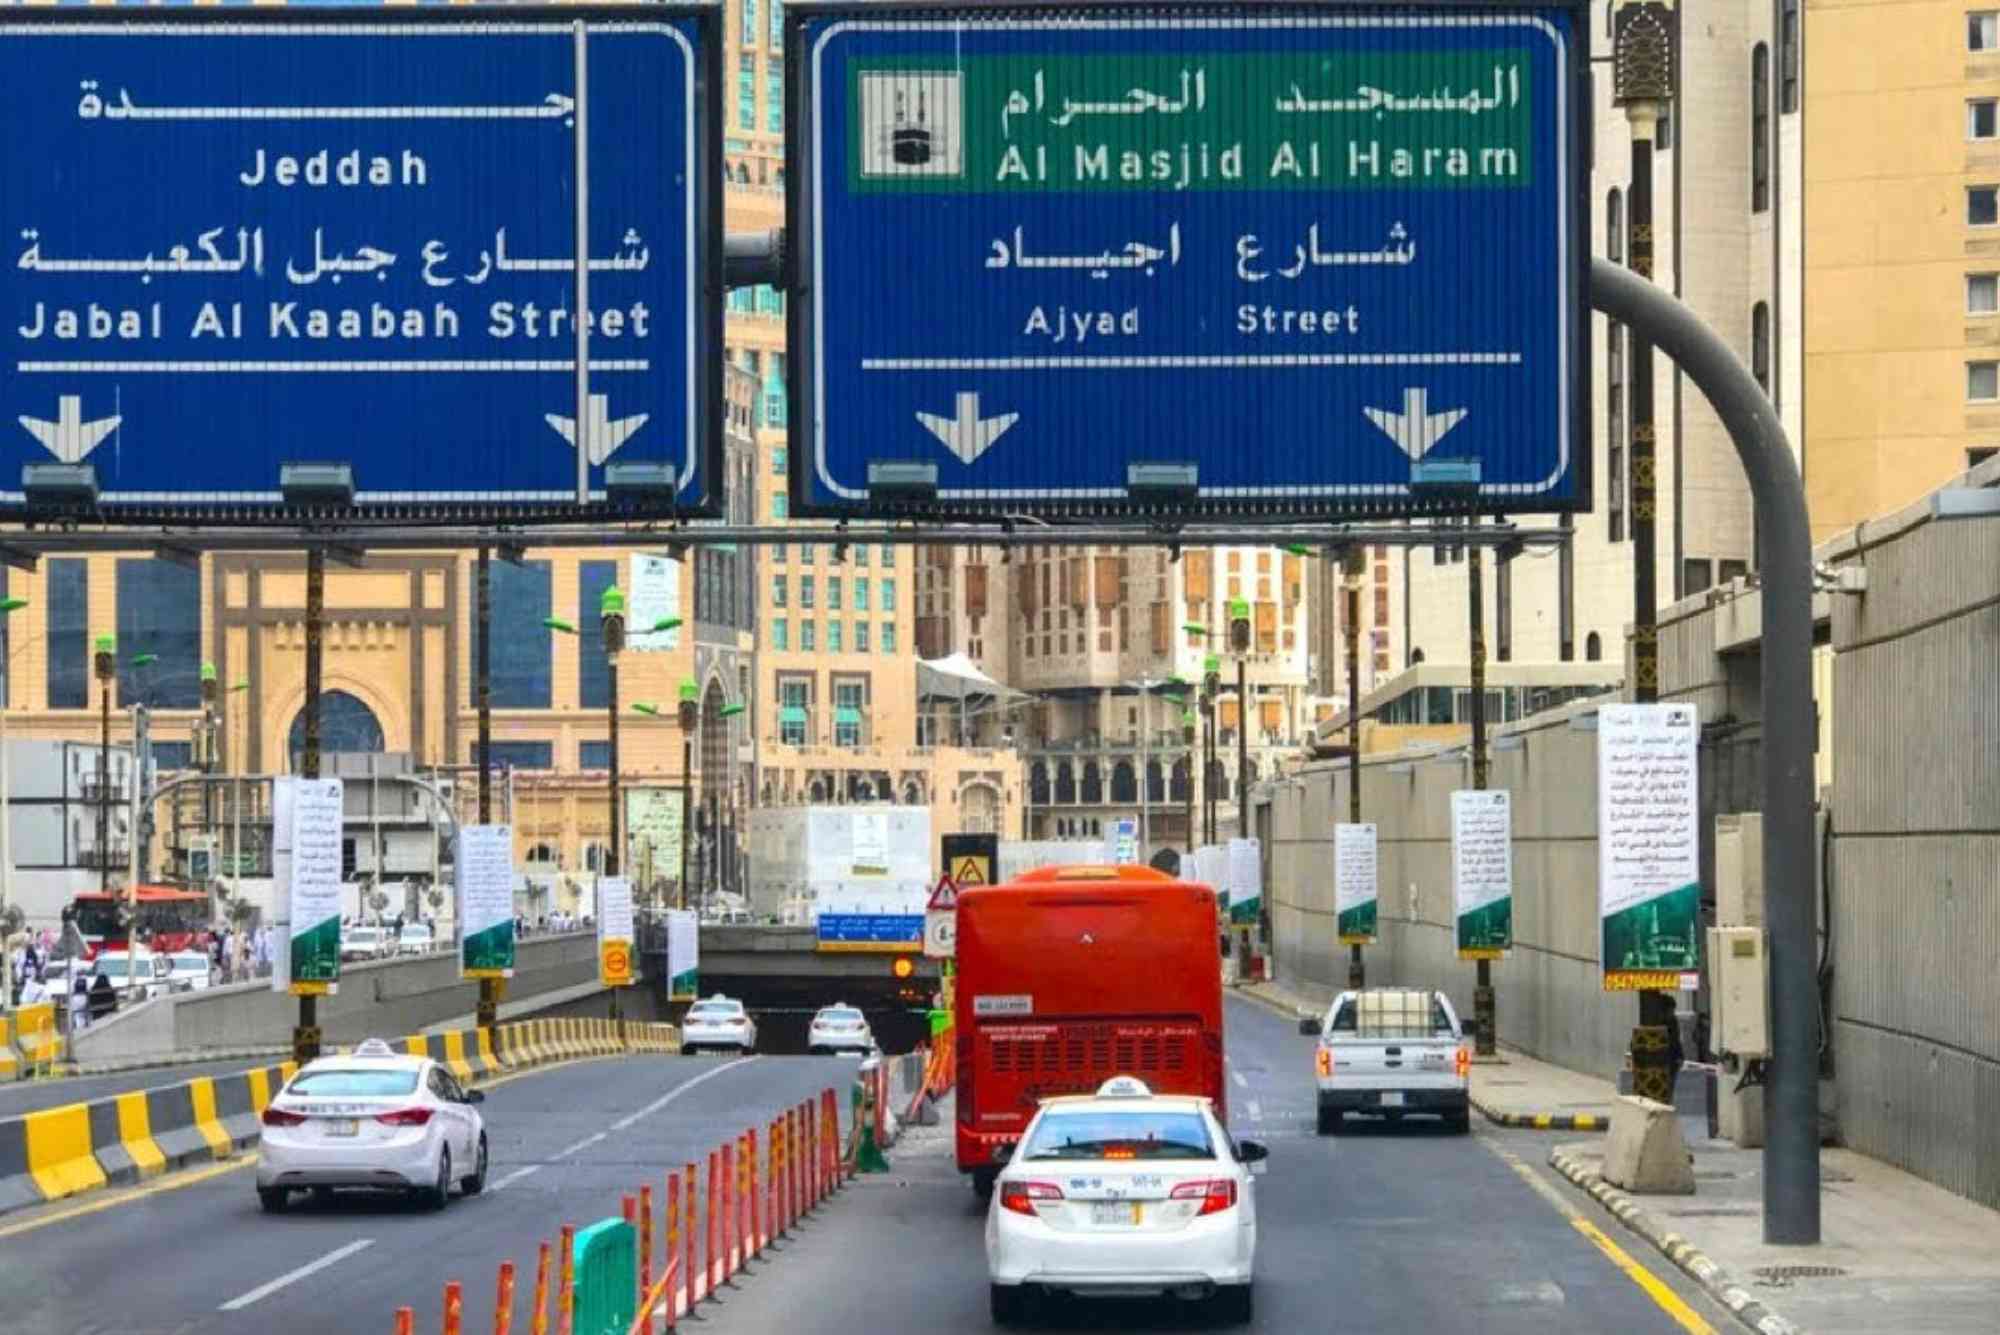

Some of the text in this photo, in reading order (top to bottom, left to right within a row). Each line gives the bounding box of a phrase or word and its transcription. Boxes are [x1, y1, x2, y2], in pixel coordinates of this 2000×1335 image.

[78, 80, 574, 128] جدة
[1002, 66, 1518, 139] المسجد الحرام
[240, 149, 427, 186] Jeddah
[997, 141, 1517, 190] Al Masjid Al Haram
[18, 227, 649, 286] شارع جبل الكعبة
[986, 221, 1415, 281] شارع اجياد
[19, 301, 649, 338] Jabal Al Kaabah Street
[1025, 304, 1359, 342] Ajyad Street
